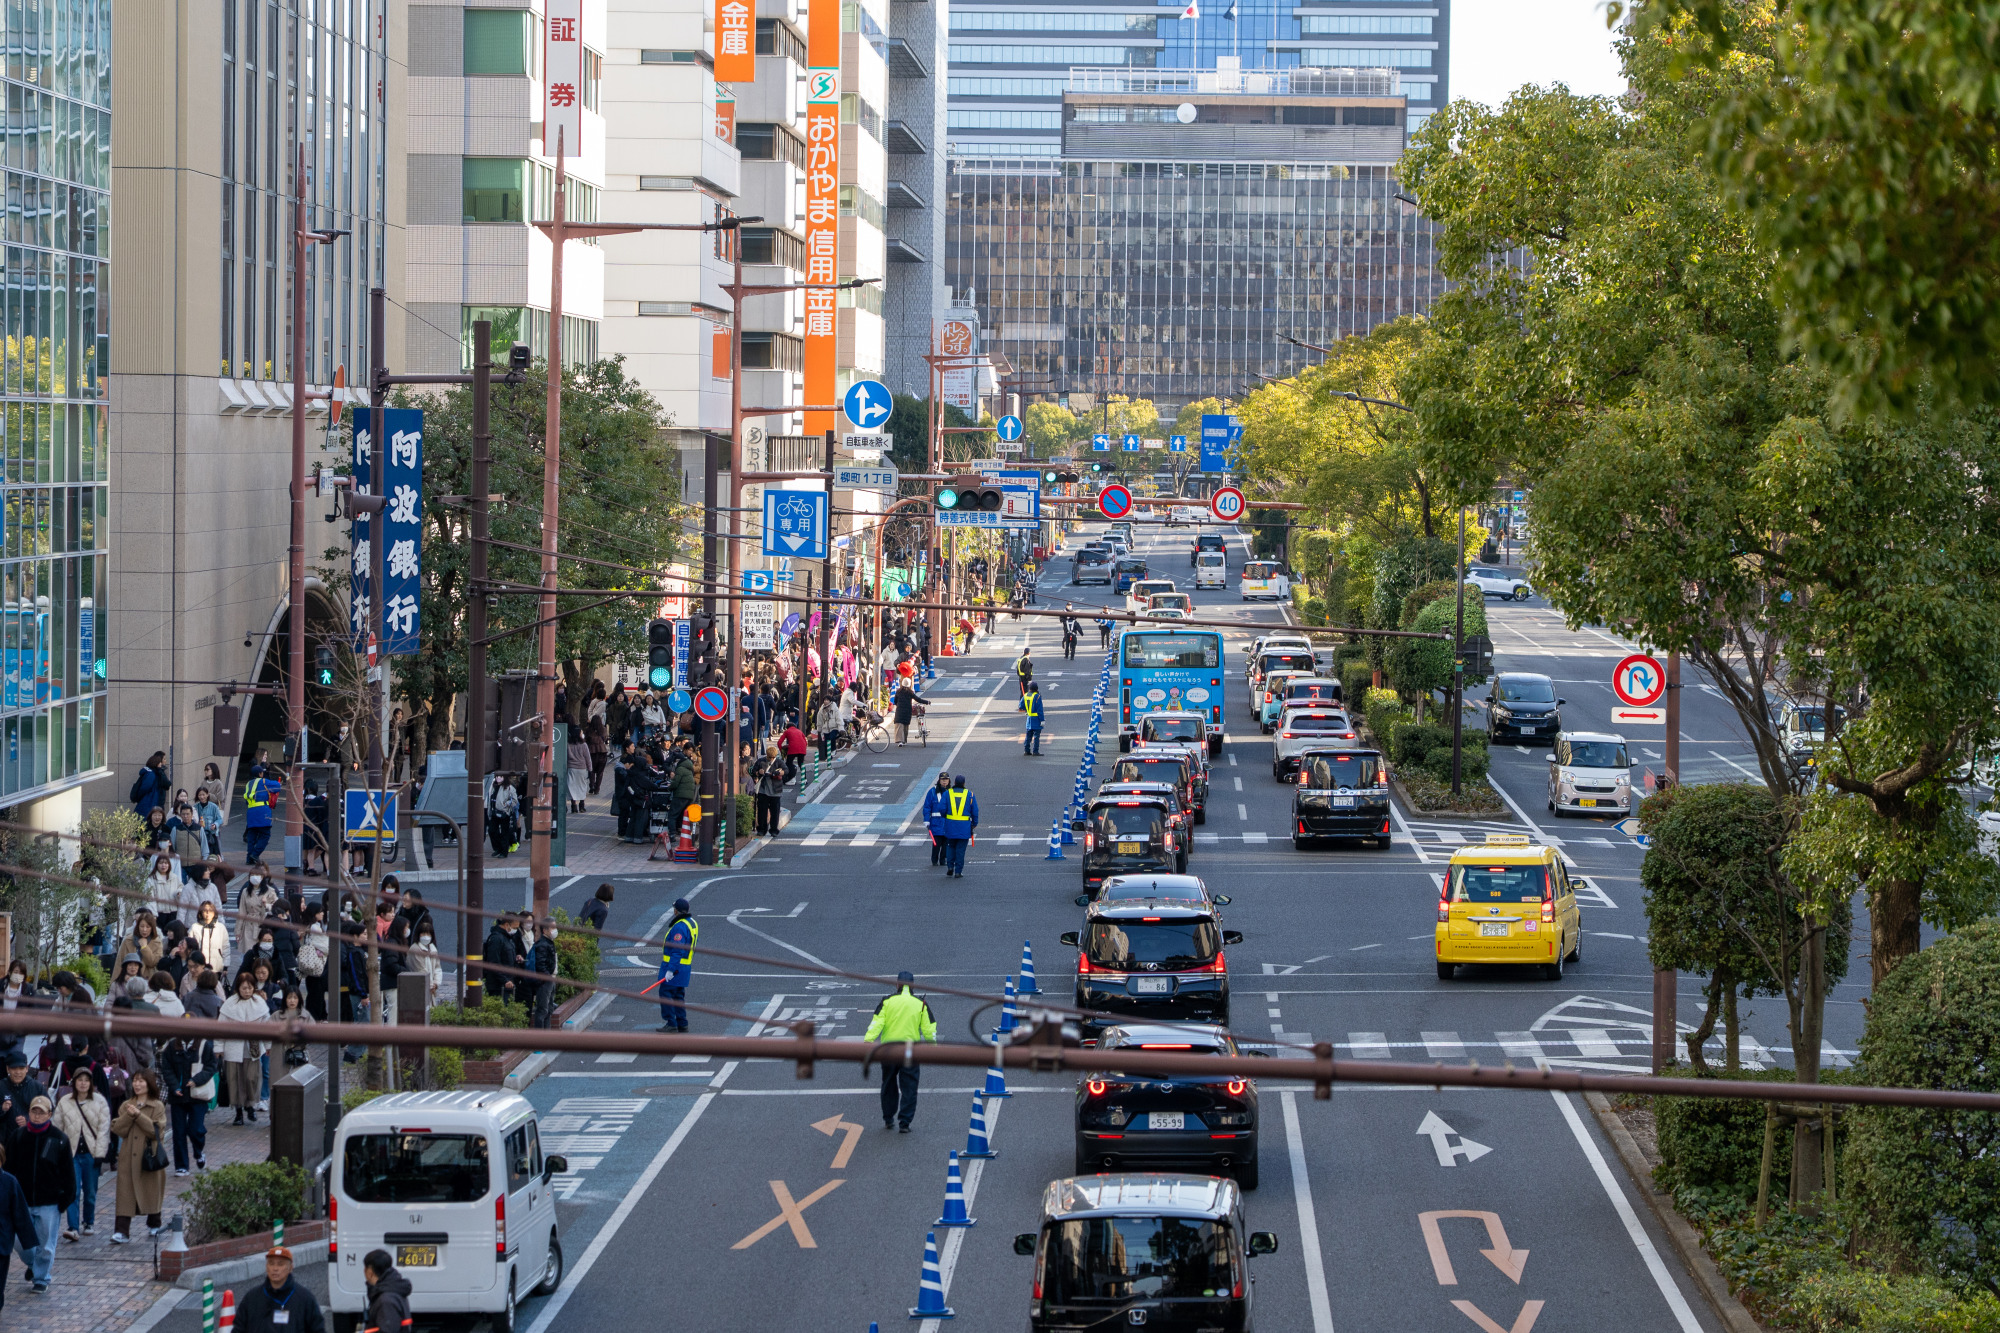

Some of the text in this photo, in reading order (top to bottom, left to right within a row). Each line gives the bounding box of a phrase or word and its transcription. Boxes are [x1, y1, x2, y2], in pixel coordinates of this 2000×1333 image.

[721, 1, 748, 56] 金庫
[550, 17, 576, 107] 証券
[807, 114, 836, 338] おかやま信用金庫
[846, 436, 889, 448] 自転車を除く
[1219, 497, 1238, 511] 40
[780, 518, 811, 532] 専用
[939, 512, 997, 524] 時差式信号機
[387, 429, 422, 634] 阿波銀行
[751, 573, 769, 597] P
[677, 624, 690, 686] 自転車専用
[1156, 1119, 1182, 1128] 55-99
[347, 1253, 356, 1262] N
[405, 1254, 435, 1264] 60-17
